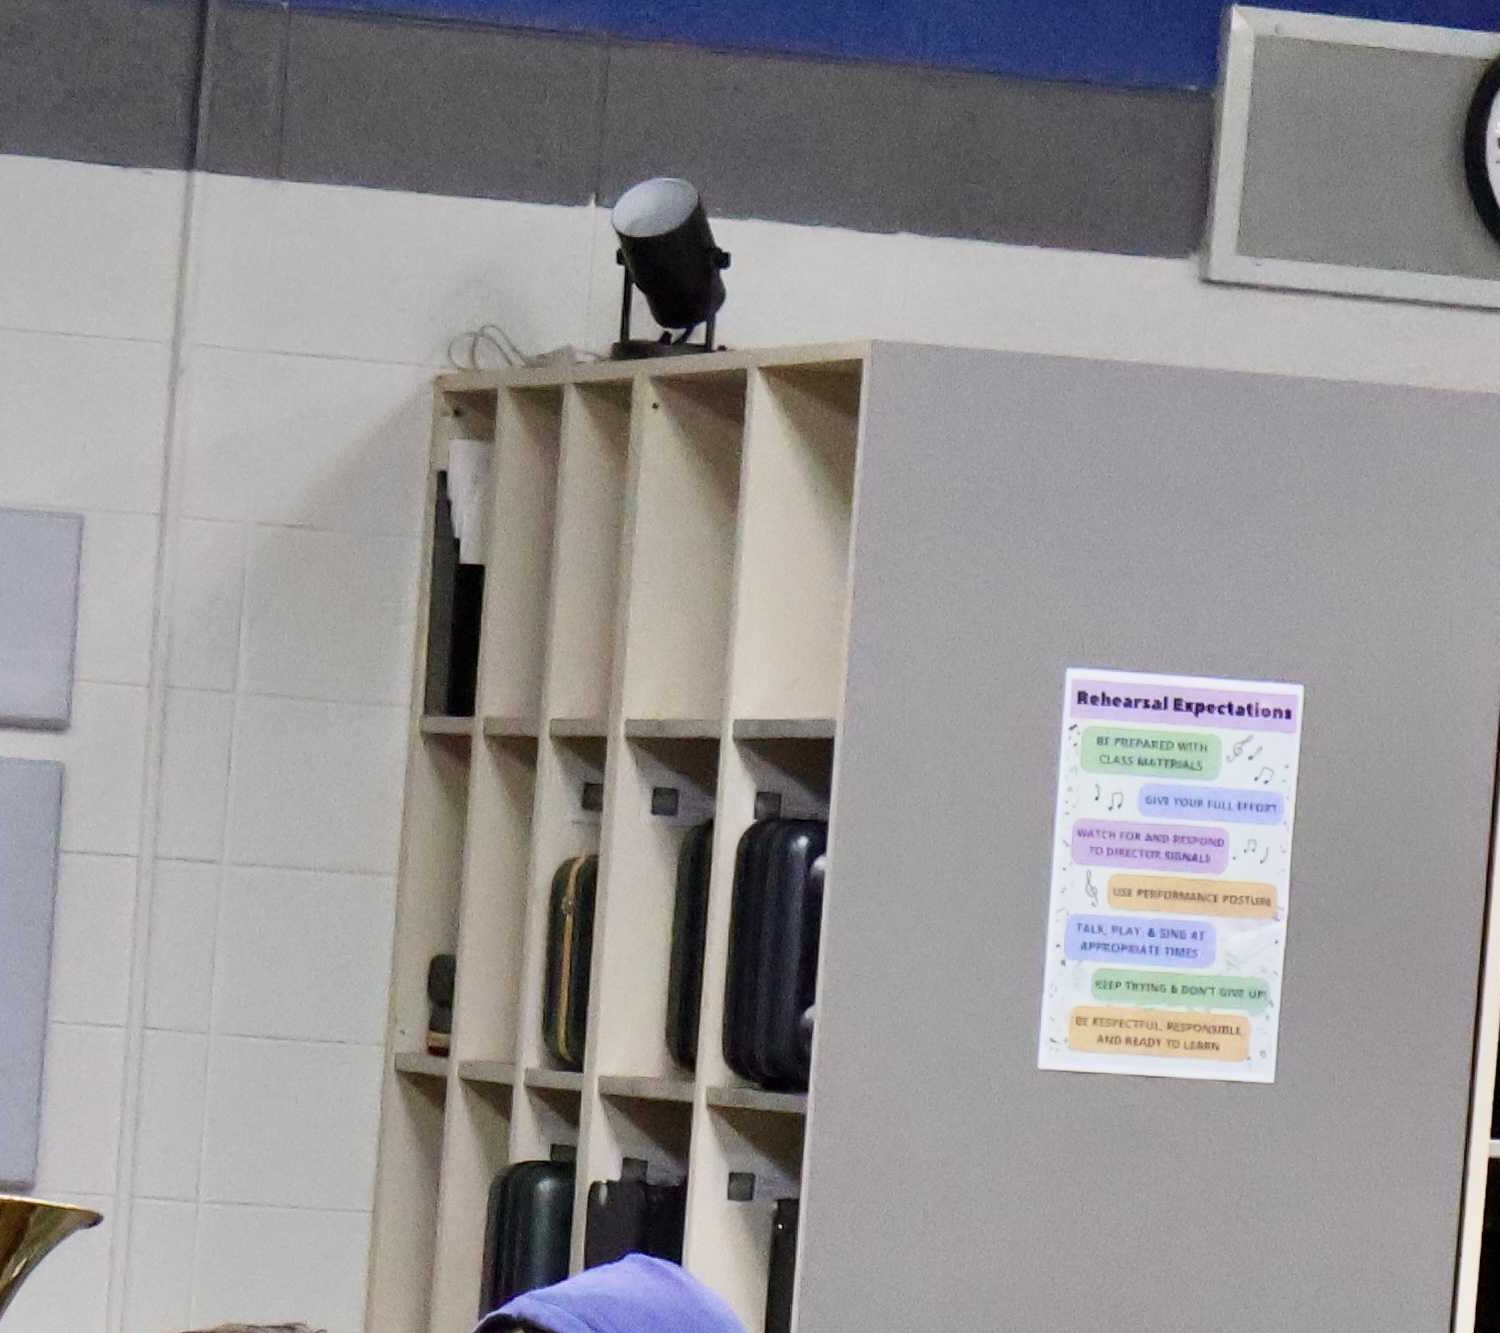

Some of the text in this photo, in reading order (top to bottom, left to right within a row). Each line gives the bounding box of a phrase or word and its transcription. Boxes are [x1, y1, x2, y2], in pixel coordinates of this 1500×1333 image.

[1077, 691, 1292, 720] Rehearsal Expectations
[1096, 736, 1208, 752] BE PREPARED WITH
[1099, 754, 1202, 771] CLASS MATERIALS
[1145, 795, 1277, 813] GIVE YOUR FULL EFFORT
[1077, 828, 1225, 848] WATCH FOR AND RESPOND
[1090, 846, 1210, 863] TO DIRECTOR SIGNALS
[1112, 888, 1272, 907] USE PERFORMANCE POSTURE
[1147, 927, 1156, 938] &
[1160, 928, 1187, 940] SING
[1191, 930, 1204, 941] AT
[1080, 941, 1199, 958] APPROPRIATE TIMES
[1095, 980, 1122, 991] KEEP
[1125, 980, 1167, 993] TRYING
[1170, 984, 1178, 994] &
[1219, 988, 1244, 998] GIVE
[1075, 1016, 1089, 1026] BE
[1096, 1034, 1220, 1051] AND READY TO LEARN
